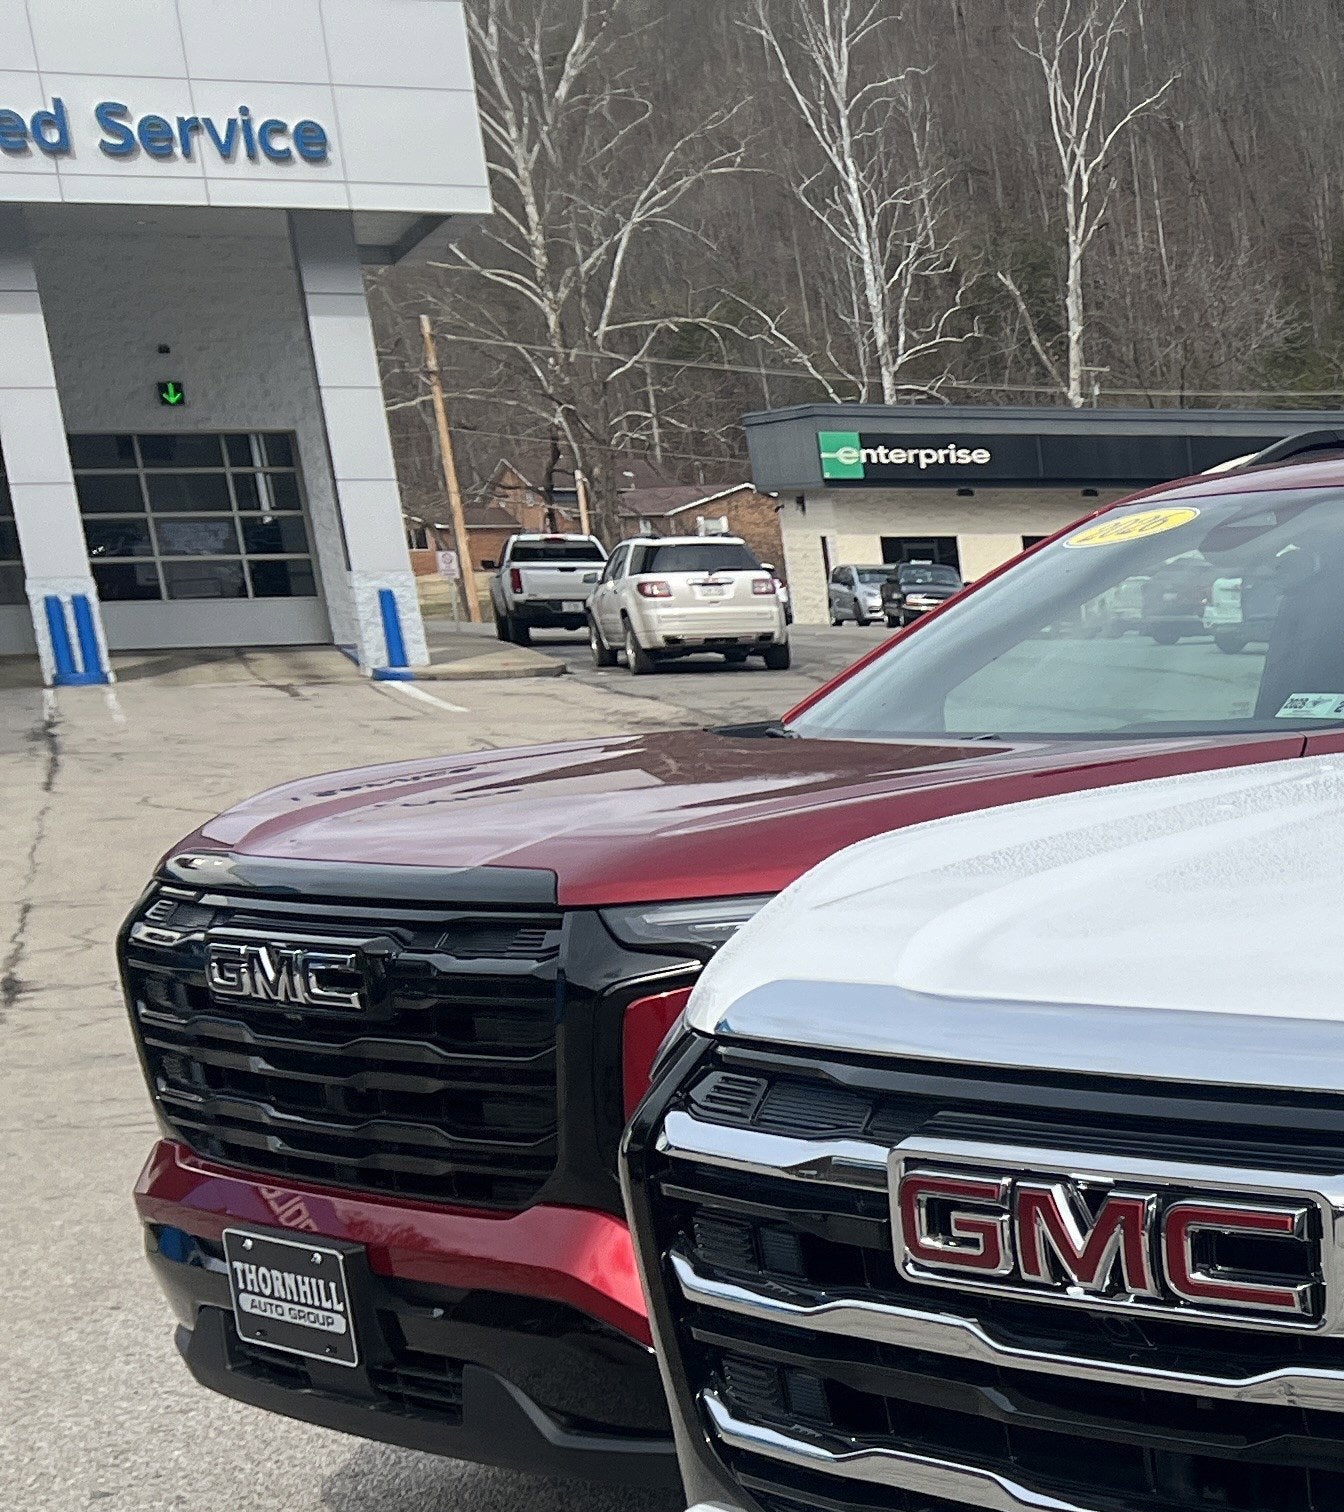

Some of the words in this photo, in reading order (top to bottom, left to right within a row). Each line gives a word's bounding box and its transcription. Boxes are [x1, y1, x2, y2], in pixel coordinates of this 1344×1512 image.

[94, 101, 329, 162] Service
[834, 443, 991, 469] enterprise
[205, 943, 361, 1010] GMC
[898, 1168, 1313, 1317] GMC
[232, 1260, 344, 1312] THORNHILL
[250, 1298, 285, 1317] AUTO
[288, 1306, 335, 1328] GROUP
